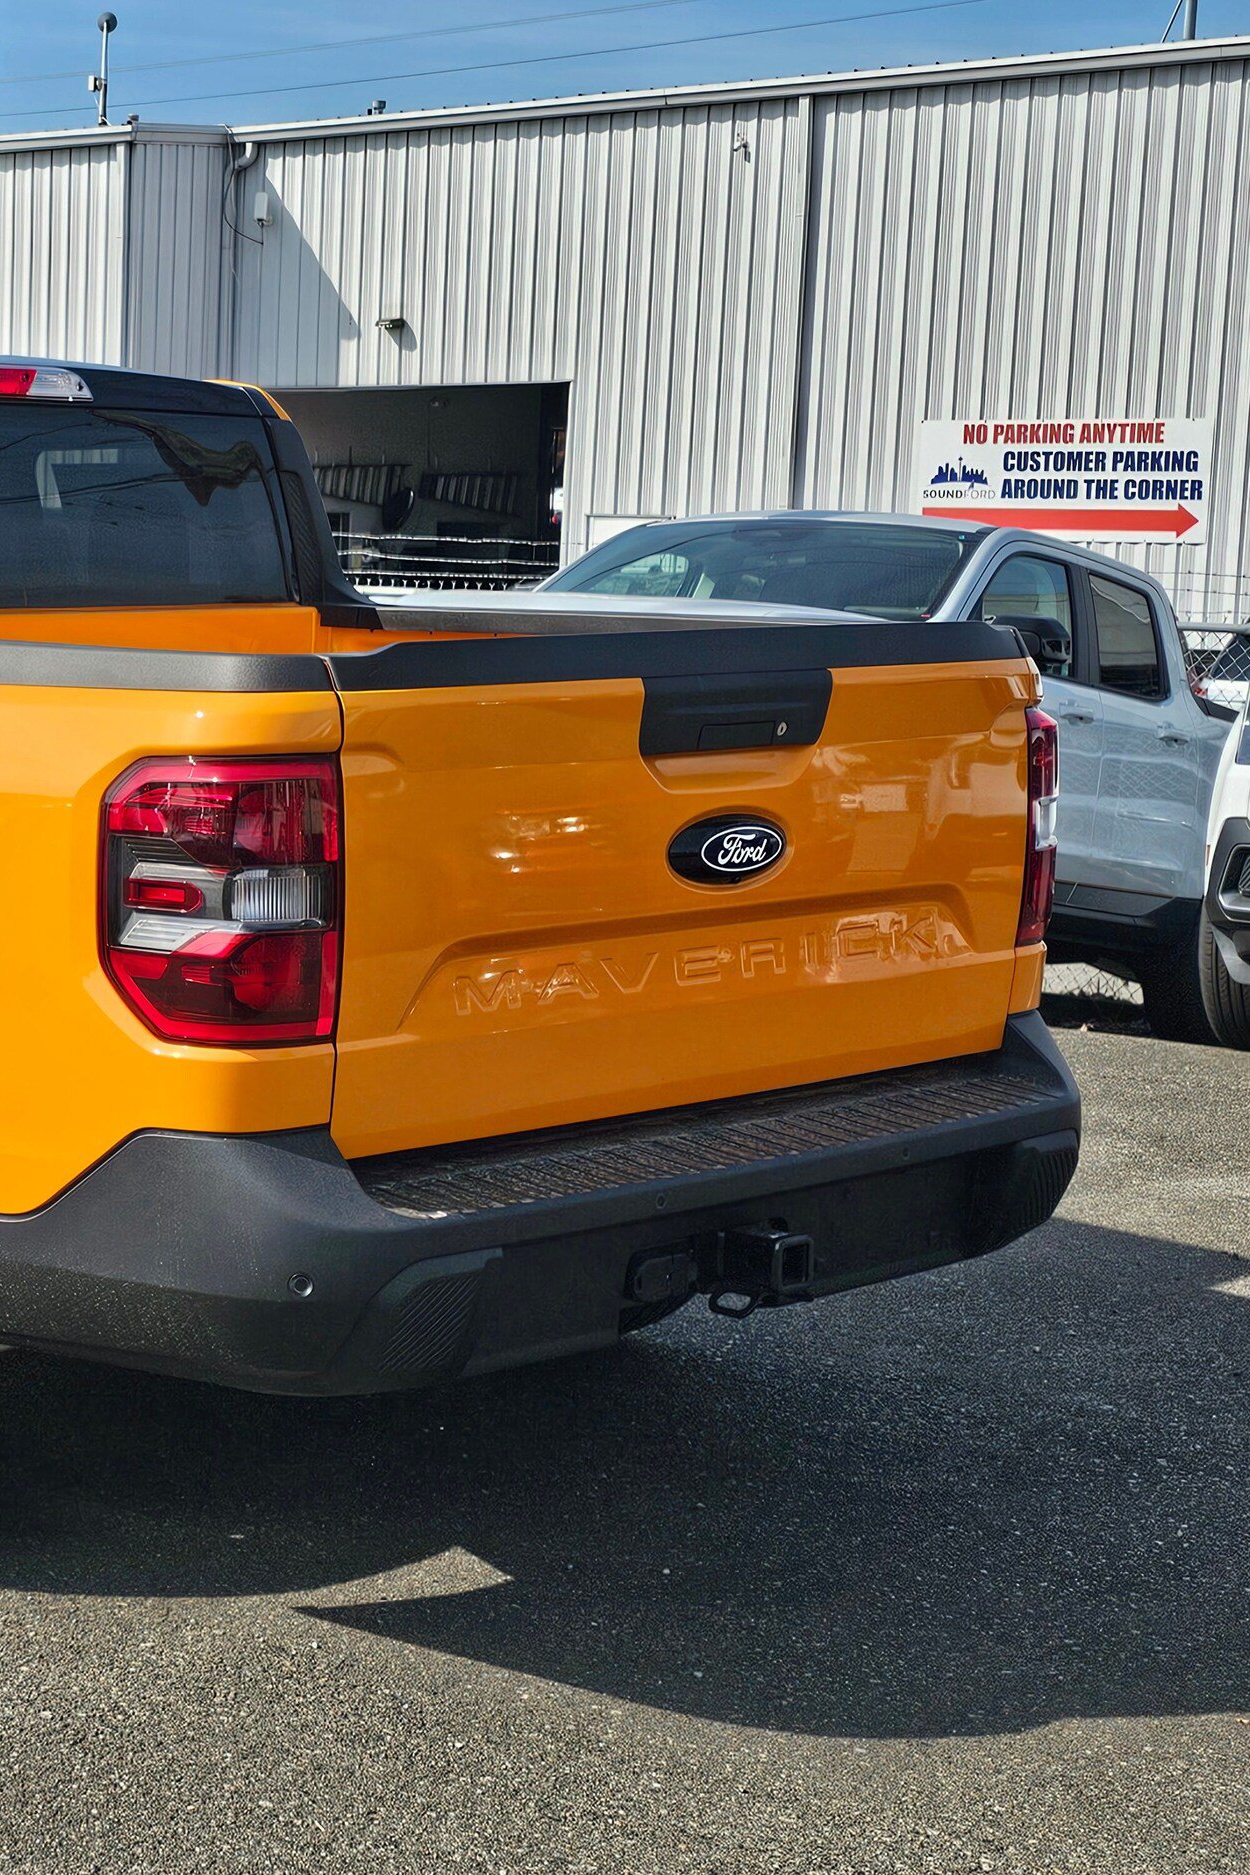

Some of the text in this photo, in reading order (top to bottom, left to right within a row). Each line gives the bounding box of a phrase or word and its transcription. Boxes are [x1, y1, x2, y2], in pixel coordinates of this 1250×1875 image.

[963, 422, 1166, 445] NO PARKING ANYTIME
[1003, 450, 1199, 472] CUSTOMER PARKING
[1000, 478, 1203, 501] AROUND THE CORNER
[717, 833, 768, 866] Ford
[452, 906, 940, 1016] MAVERICK
